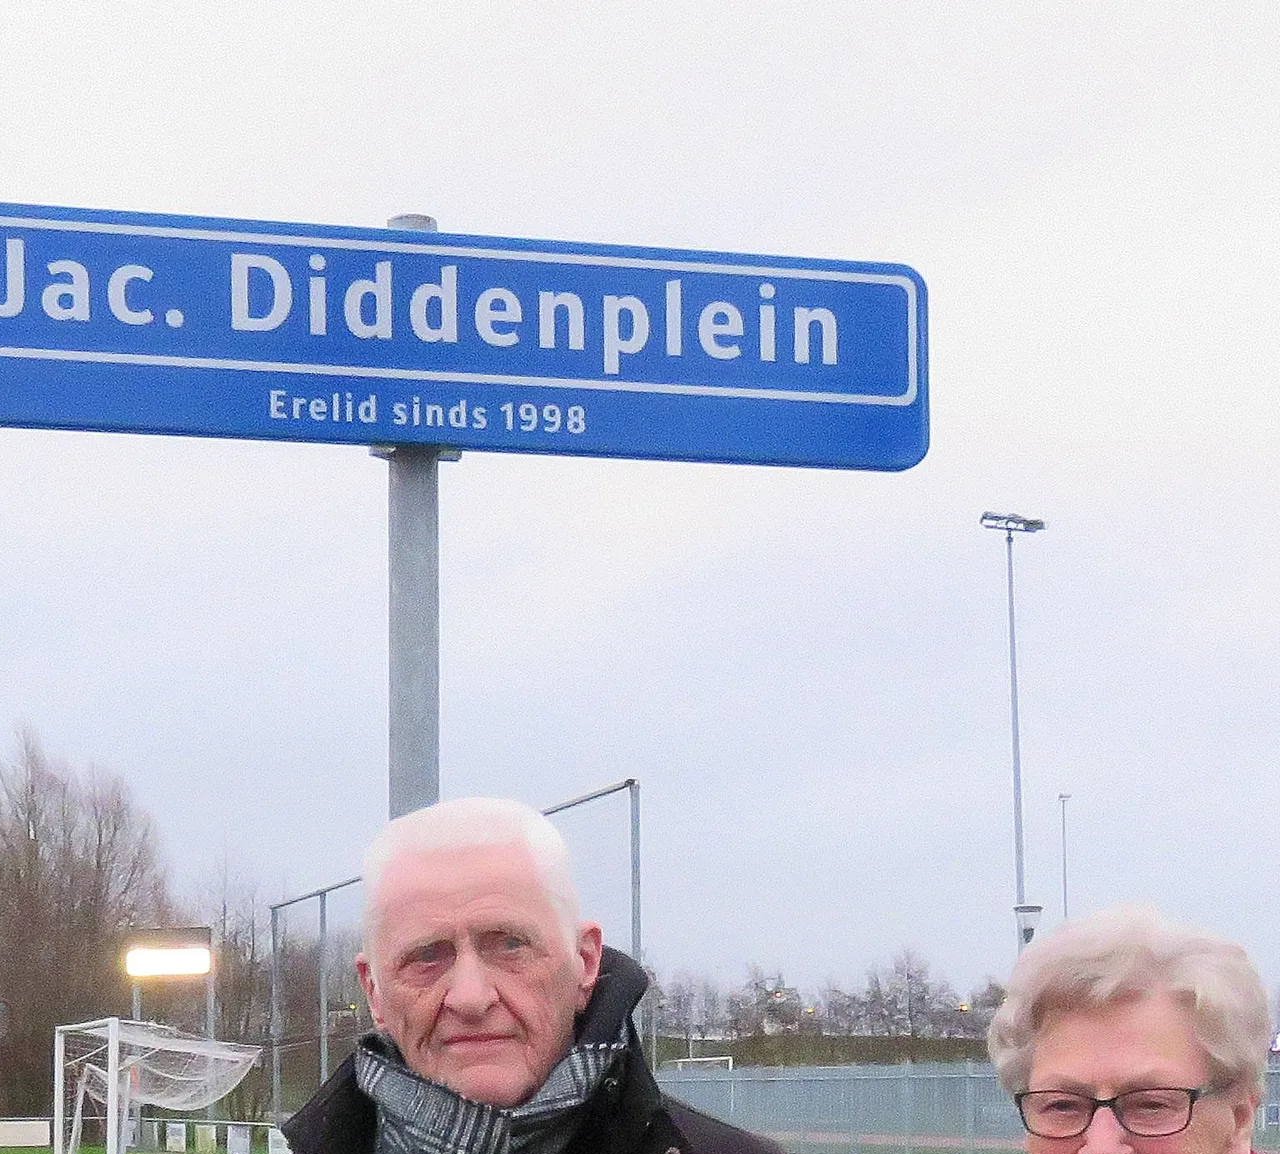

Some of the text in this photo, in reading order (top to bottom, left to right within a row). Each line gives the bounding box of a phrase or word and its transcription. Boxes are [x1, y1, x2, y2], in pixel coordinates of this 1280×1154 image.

[230, 252, 838, 375] Diddenplein
[269, 389, 587, 434] Erelid sinds 1998
